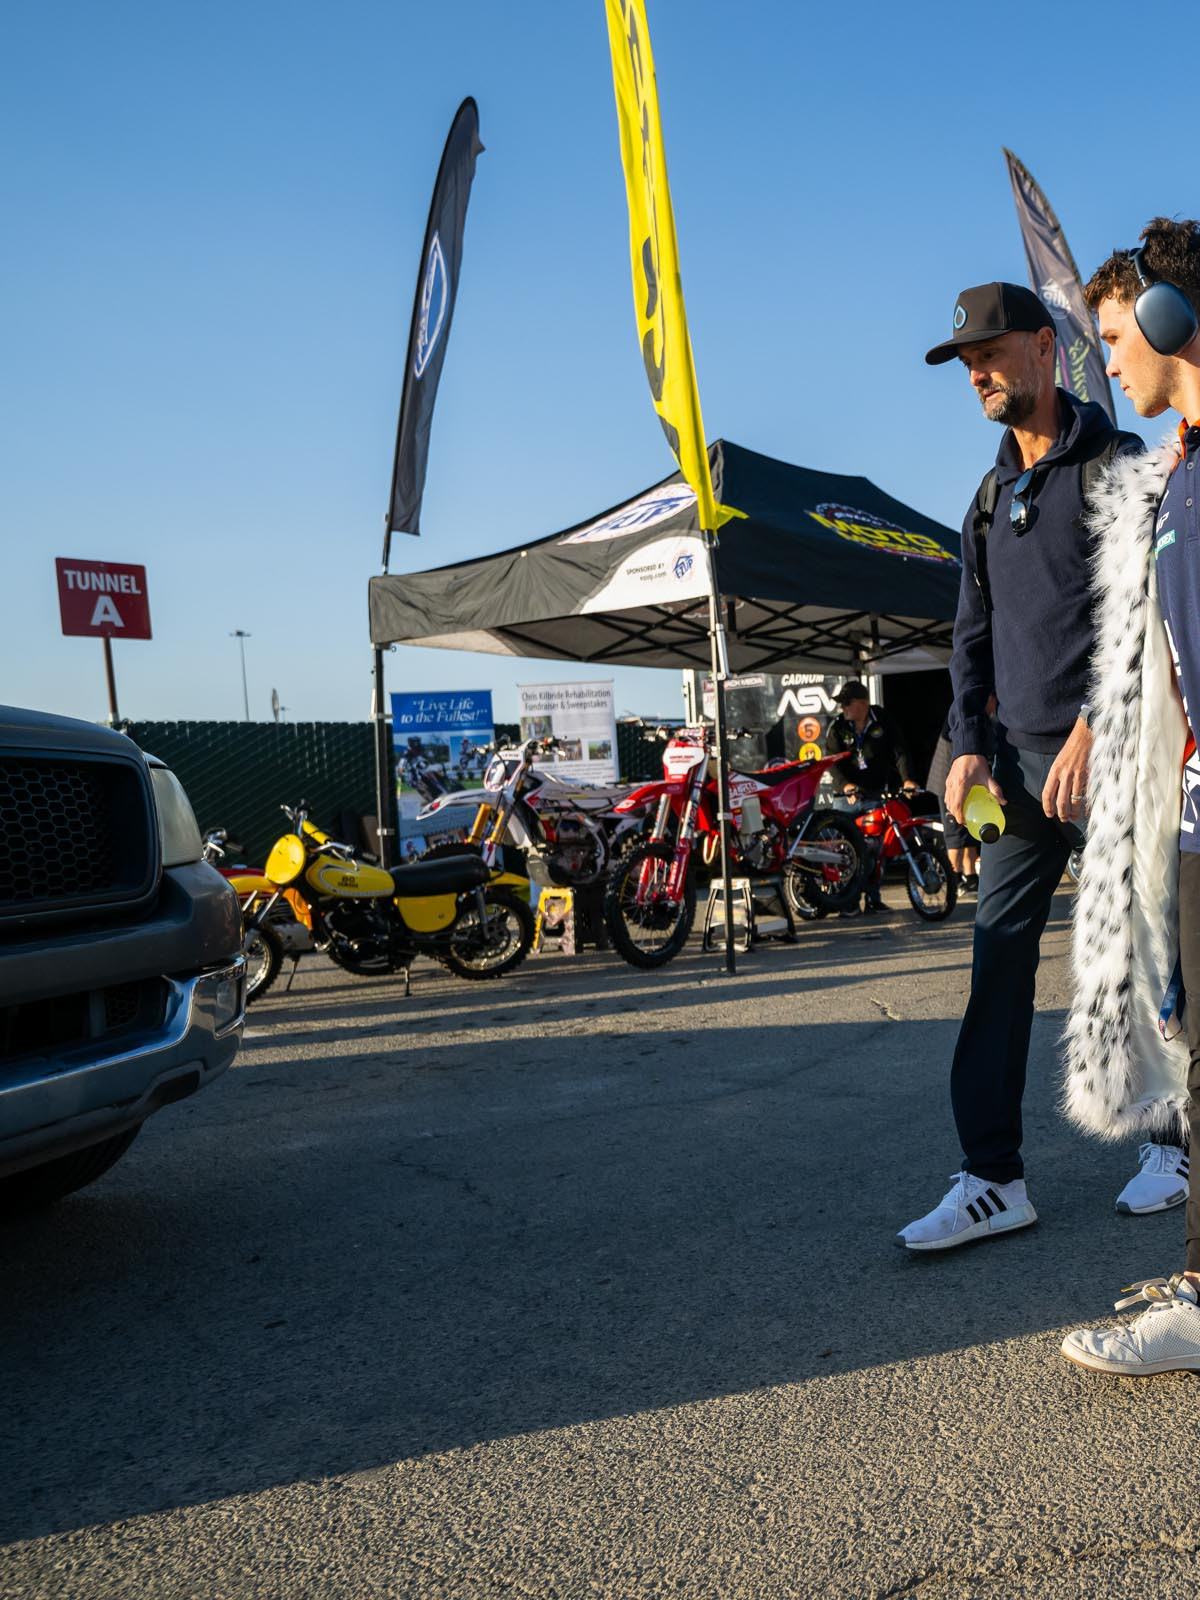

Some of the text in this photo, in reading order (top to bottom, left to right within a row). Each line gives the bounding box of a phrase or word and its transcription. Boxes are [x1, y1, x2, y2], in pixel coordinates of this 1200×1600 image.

[626, 564, 657, 576] SPONSORED
[64, 570, 141, 594] TUNNEL
[90, 595, 125, 627] A
[781, 673, 825, 686] CADNUM
[565, 689, 611, 699] Rehabilitation
[777, 683, 842, 717] ASV
[449, 697, 474, 710] Life
[525, 702, 558, 712] Fundraiser
[566, 700, 608, 711] Sweepstakes
[401, 713, 414, 724] to
[415, 712, 434, 723] the
